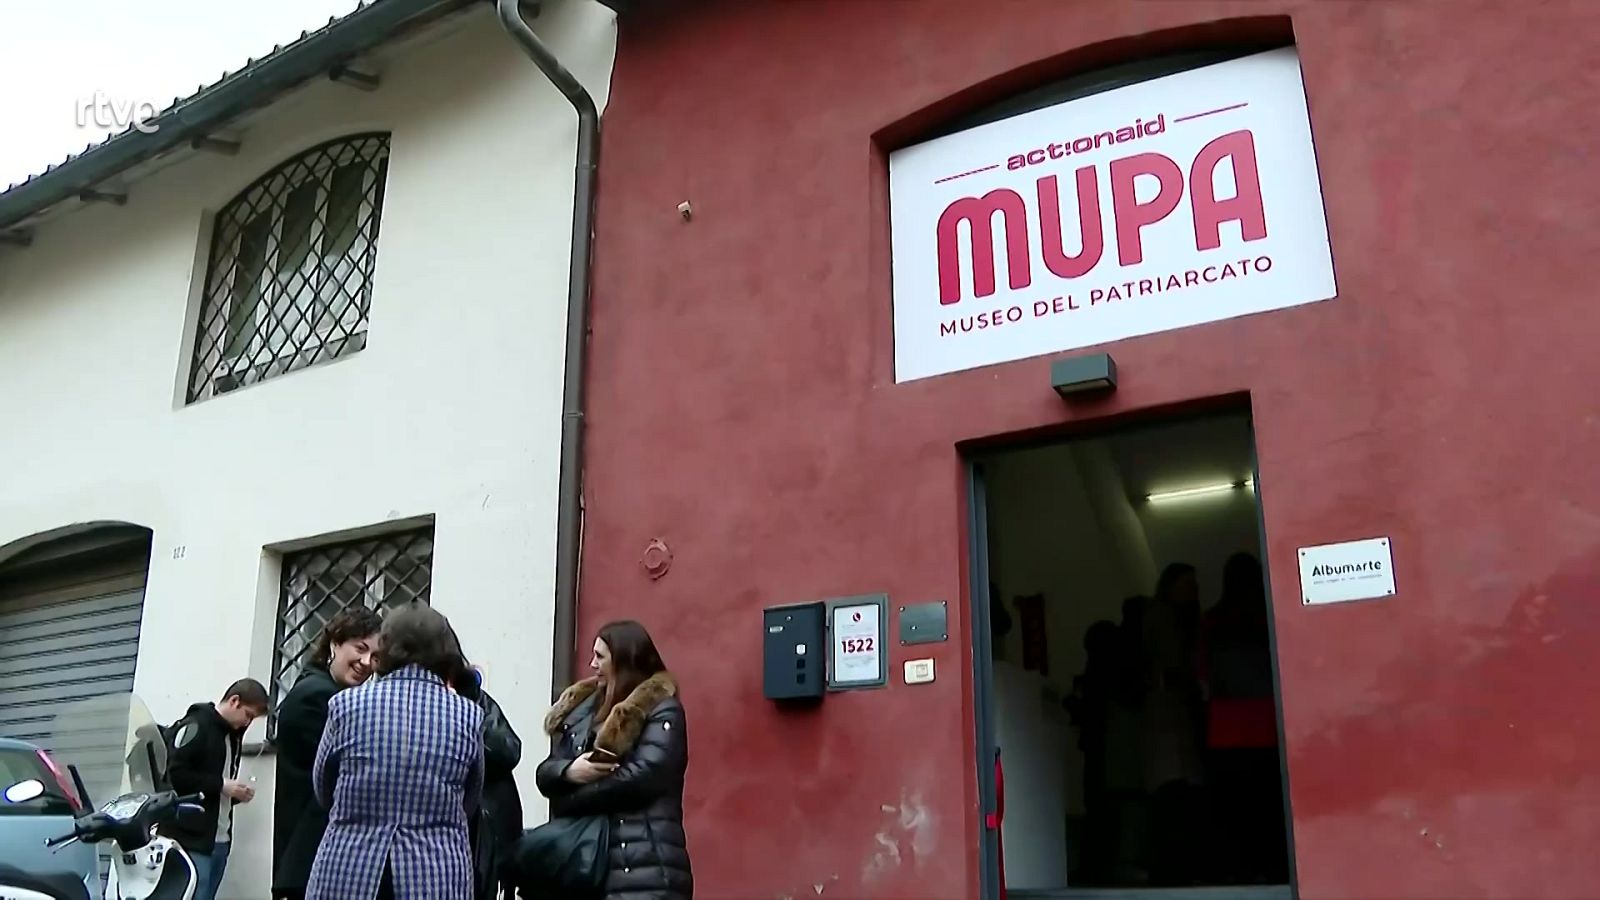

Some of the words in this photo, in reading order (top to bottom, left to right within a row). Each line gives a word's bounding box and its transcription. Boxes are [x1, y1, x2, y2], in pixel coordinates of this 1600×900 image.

[937, 129, 1267, 304] MUPA
[940, 306, 1022, 336] MUSEO
[1033, 296, 1079, 317] DEL
[1090, 256, 1272, 305] PATRIARCATO
[841, 638, 874, 653] 1522
